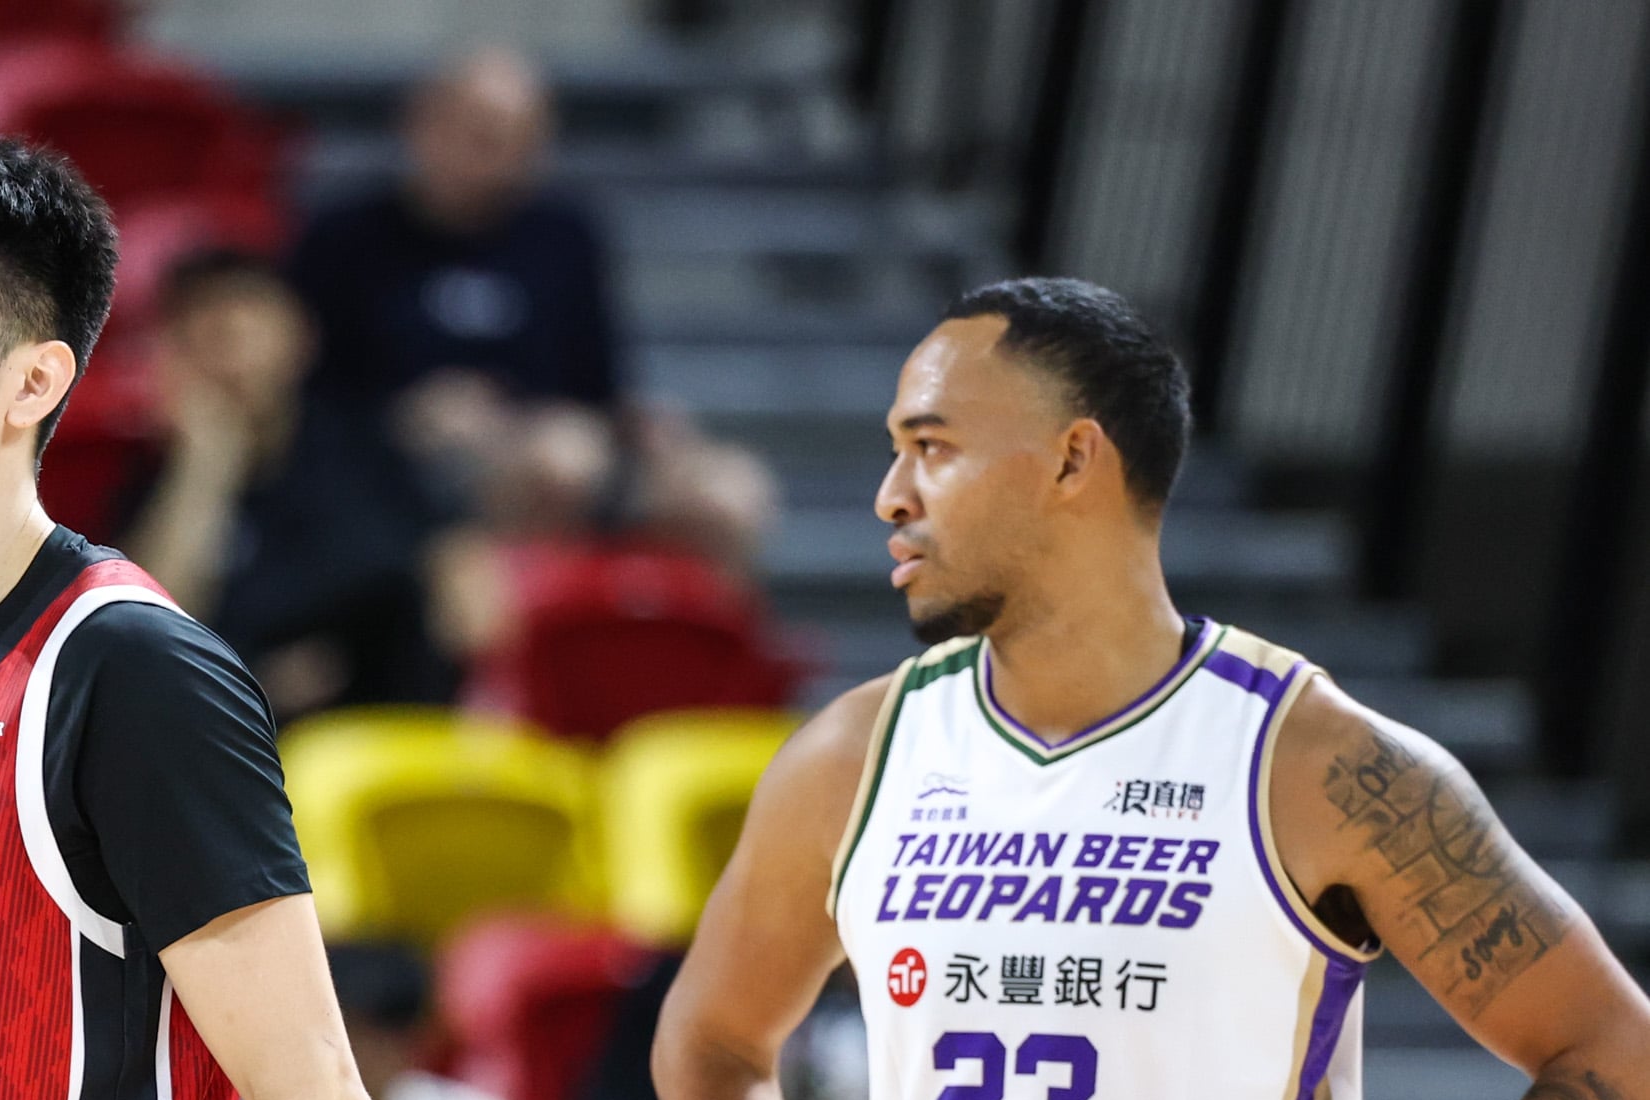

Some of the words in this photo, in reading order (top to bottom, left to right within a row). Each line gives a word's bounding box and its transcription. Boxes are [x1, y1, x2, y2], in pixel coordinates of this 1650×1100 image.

[890, 832, 1069, 868] TAIWAN
[1072, 834, 1220, 875] BEER
[874, 873, 1213, 930] LEOPARDS
[944, 953, 1168, 1012] 永豐銀行
